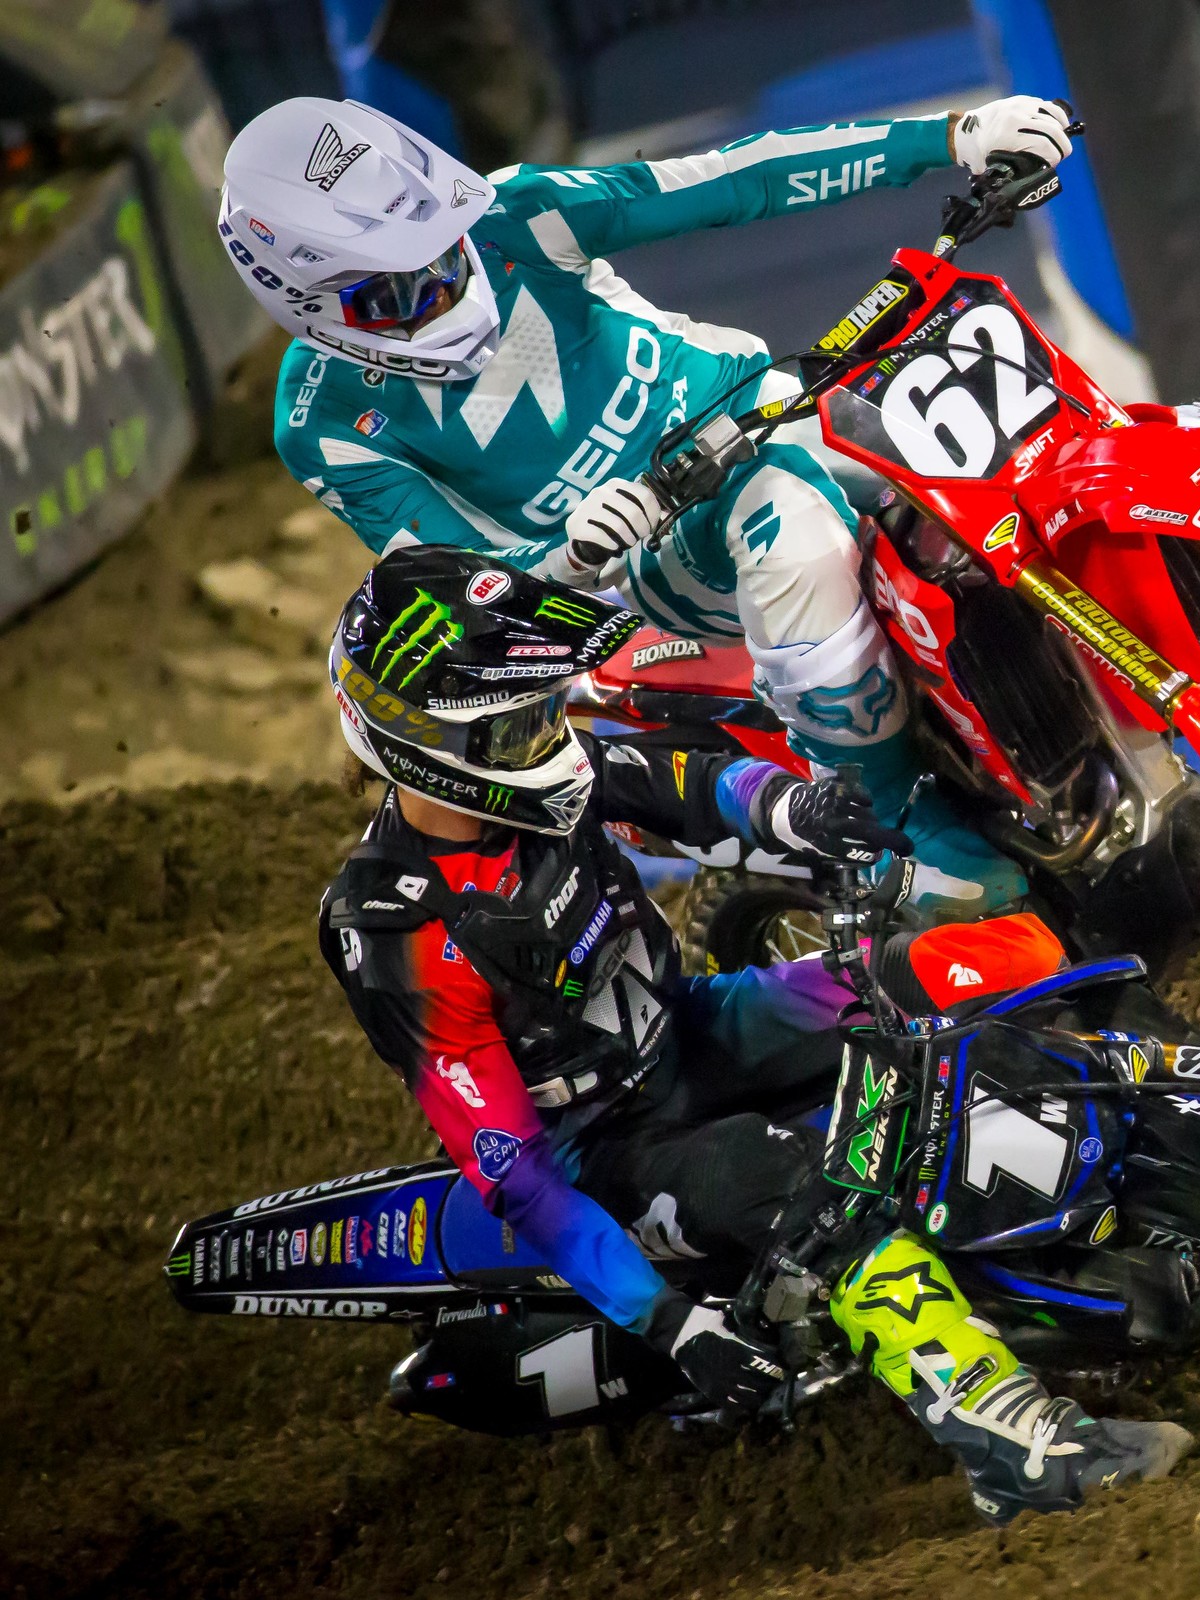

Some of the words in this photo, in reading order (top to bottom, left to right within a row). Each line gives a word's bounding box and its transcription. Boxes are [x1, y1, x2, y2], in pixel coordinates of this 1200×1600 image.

[319, 144, 371, 191] HONDA
[787, 153, 885, 206] SHIF
[817, 281, 904, 353] PROTAPER
[306, 324, 451, 379] GEICO
[880, 303, 1058, 479] 62
[521, 325, 662, 526] GEICO
[1014, 428, 1056, 484] SHIFT
[473, 574, 504, 600] BELL
[508, 646, 551, 657] FLEX
[576, 610, 638, 663] MONSTER
[600, 617, 641, 656] ENERGY
[1061, 589, 1162, 665] Factory
[481, 663, 573, 680] apdesigns
[631, 640, 702, 670] HONDA
[335, 688, 361, 729] BELL
[337, 656, 444, 746] 100%
[428, 690, 510, 711] SHIMANO
[383, 746, 478, 799] MONSTER
[393, 766, 460, 800] ENERGY
[544, 866, 580, 930] thor
[578, 900, 613, 951] YAMAHA
[966, 1086, 1068, 1198] 1
[193, 1238, 206, 1286] YAMAHA
[232, 1294, 388, 1318] DUNLOP
[518, 1325, 602, 1418] 1
[600, 1376, 628, 1400] W
